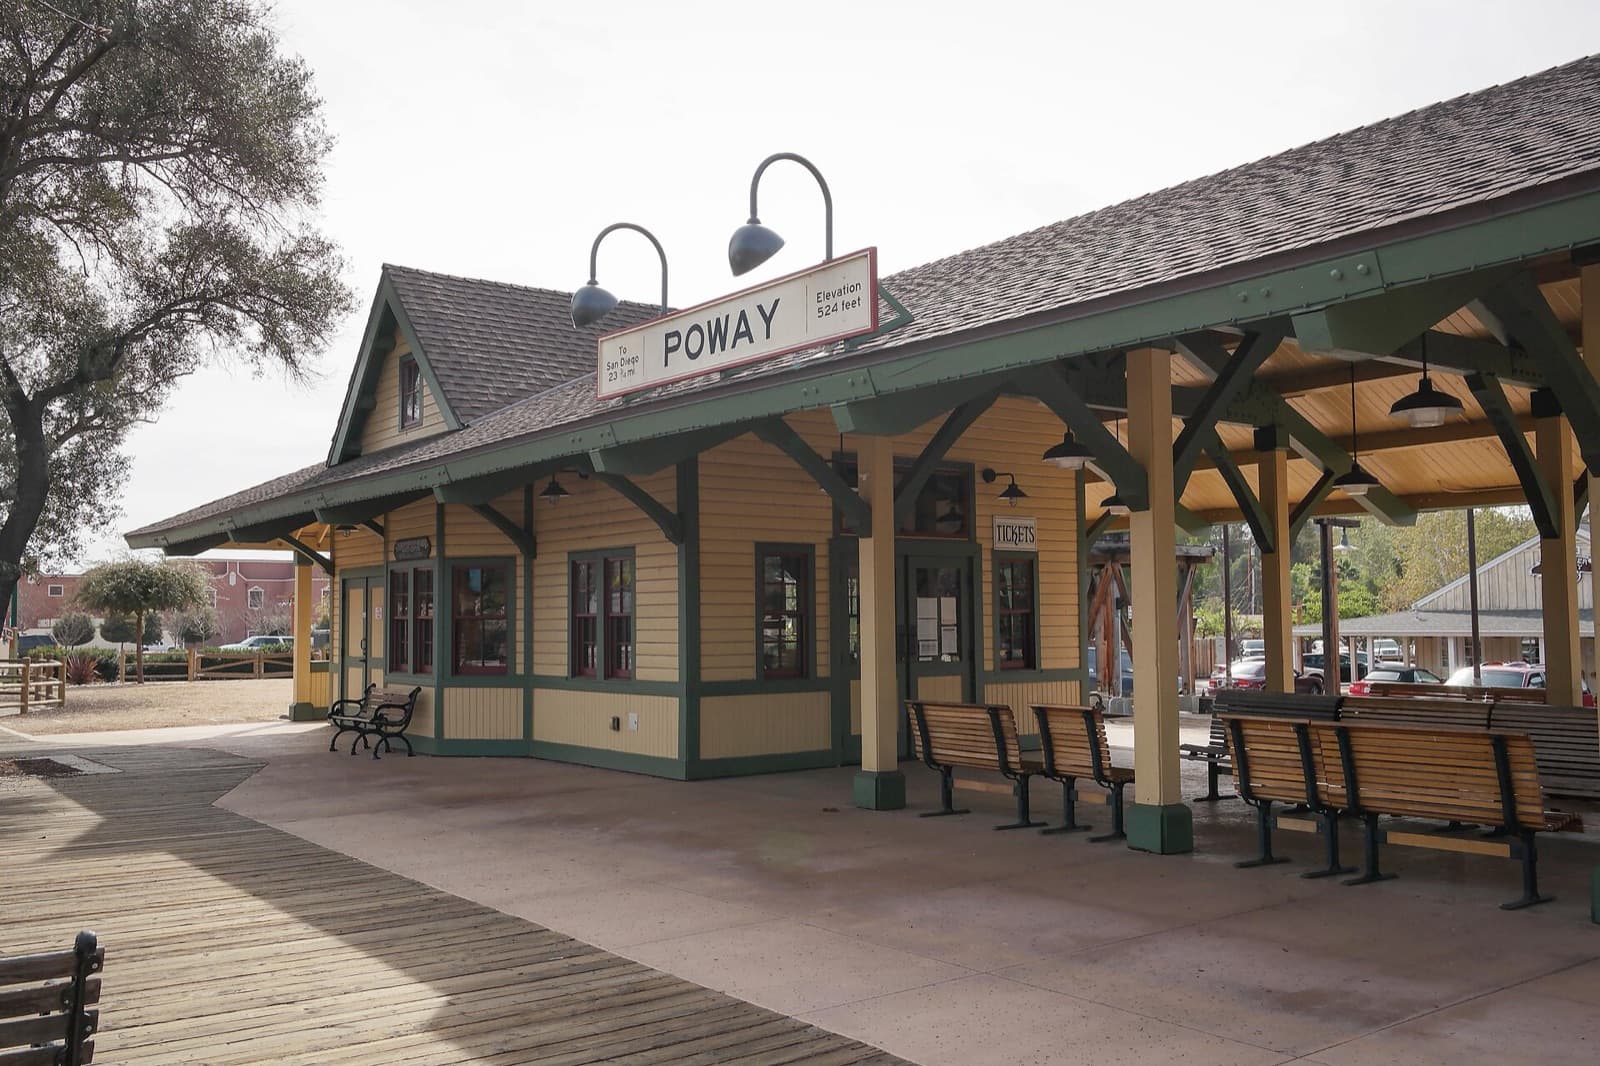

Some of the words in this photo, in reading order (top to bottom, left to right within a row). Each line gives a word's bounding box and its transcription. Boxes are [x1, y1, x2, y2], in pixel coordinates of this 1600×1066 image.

[816, 282, 862, 303] Elevation
[817, 302, 838, 318] 524
[841, 296, 861, 311] feet
[664, 298, 780, 367] POWAY
[618, 345, 627, 356] To
[606, 361, 619, 371] San
[620, 355, 639, 368] Diego
[608, 371, 618, 382] 23
[997, 525, 1035, 546] TICKETS
